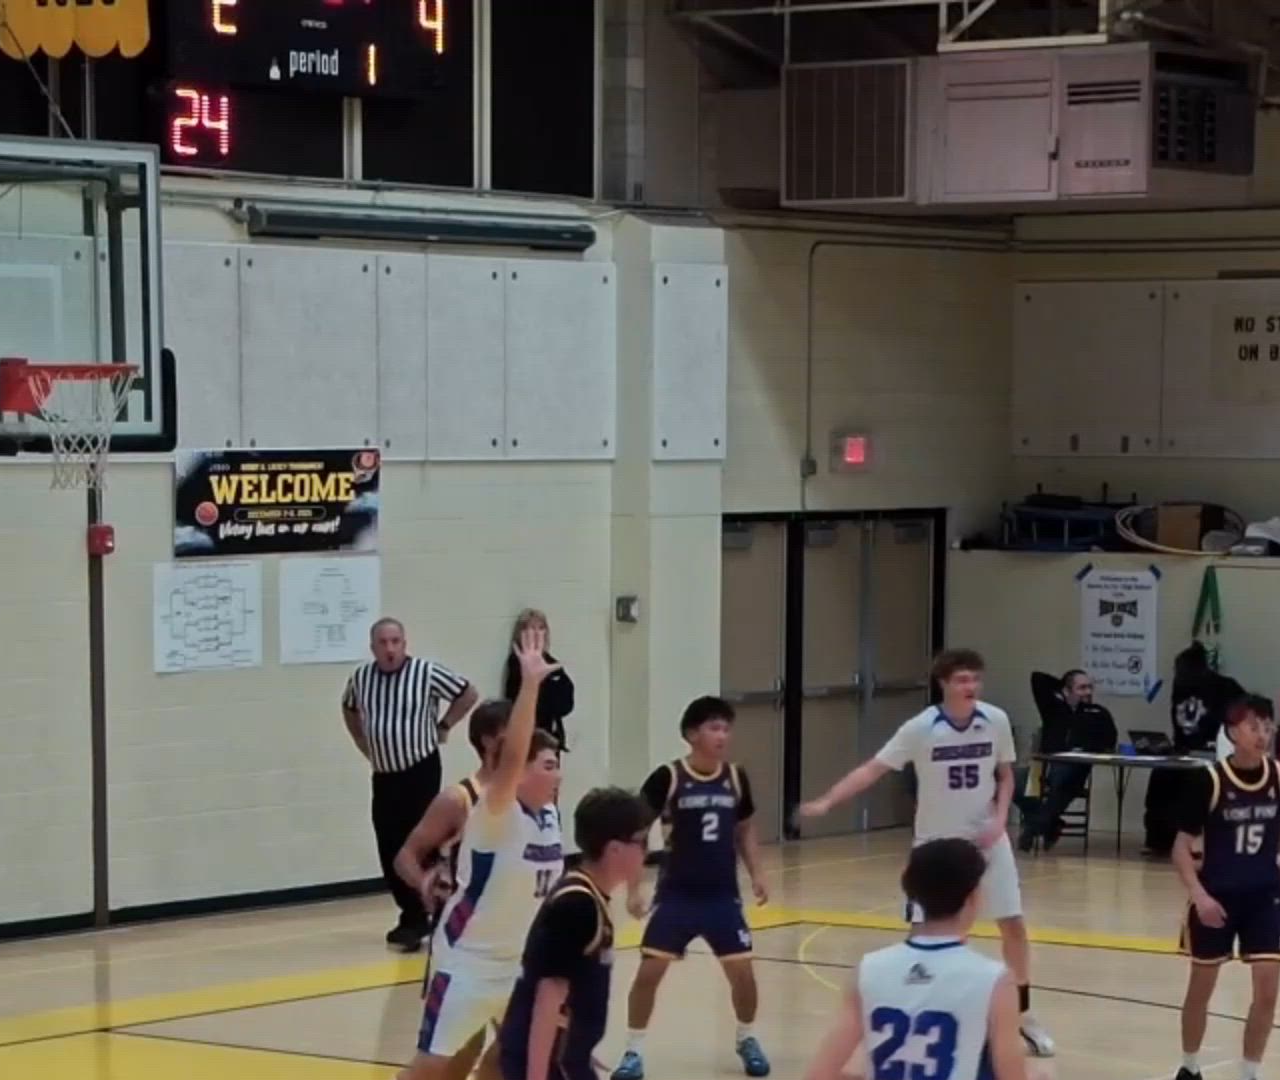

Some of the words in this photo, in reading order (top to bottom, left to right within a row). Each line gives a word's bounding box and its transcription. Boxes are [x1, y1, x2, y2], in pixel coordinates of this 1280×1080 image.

[289, 49, 339, 78] period
[368, 44, 376, 85] 1
[173, 89, 228, 154] 24
[1234, 317, 1255, 333] NO
[209, 473, 356, 505] WELCOME
[949, 764, 979, 789] 55
[702, 812, 719, 841] 2
[1235, 824, 1265, 855] 15
